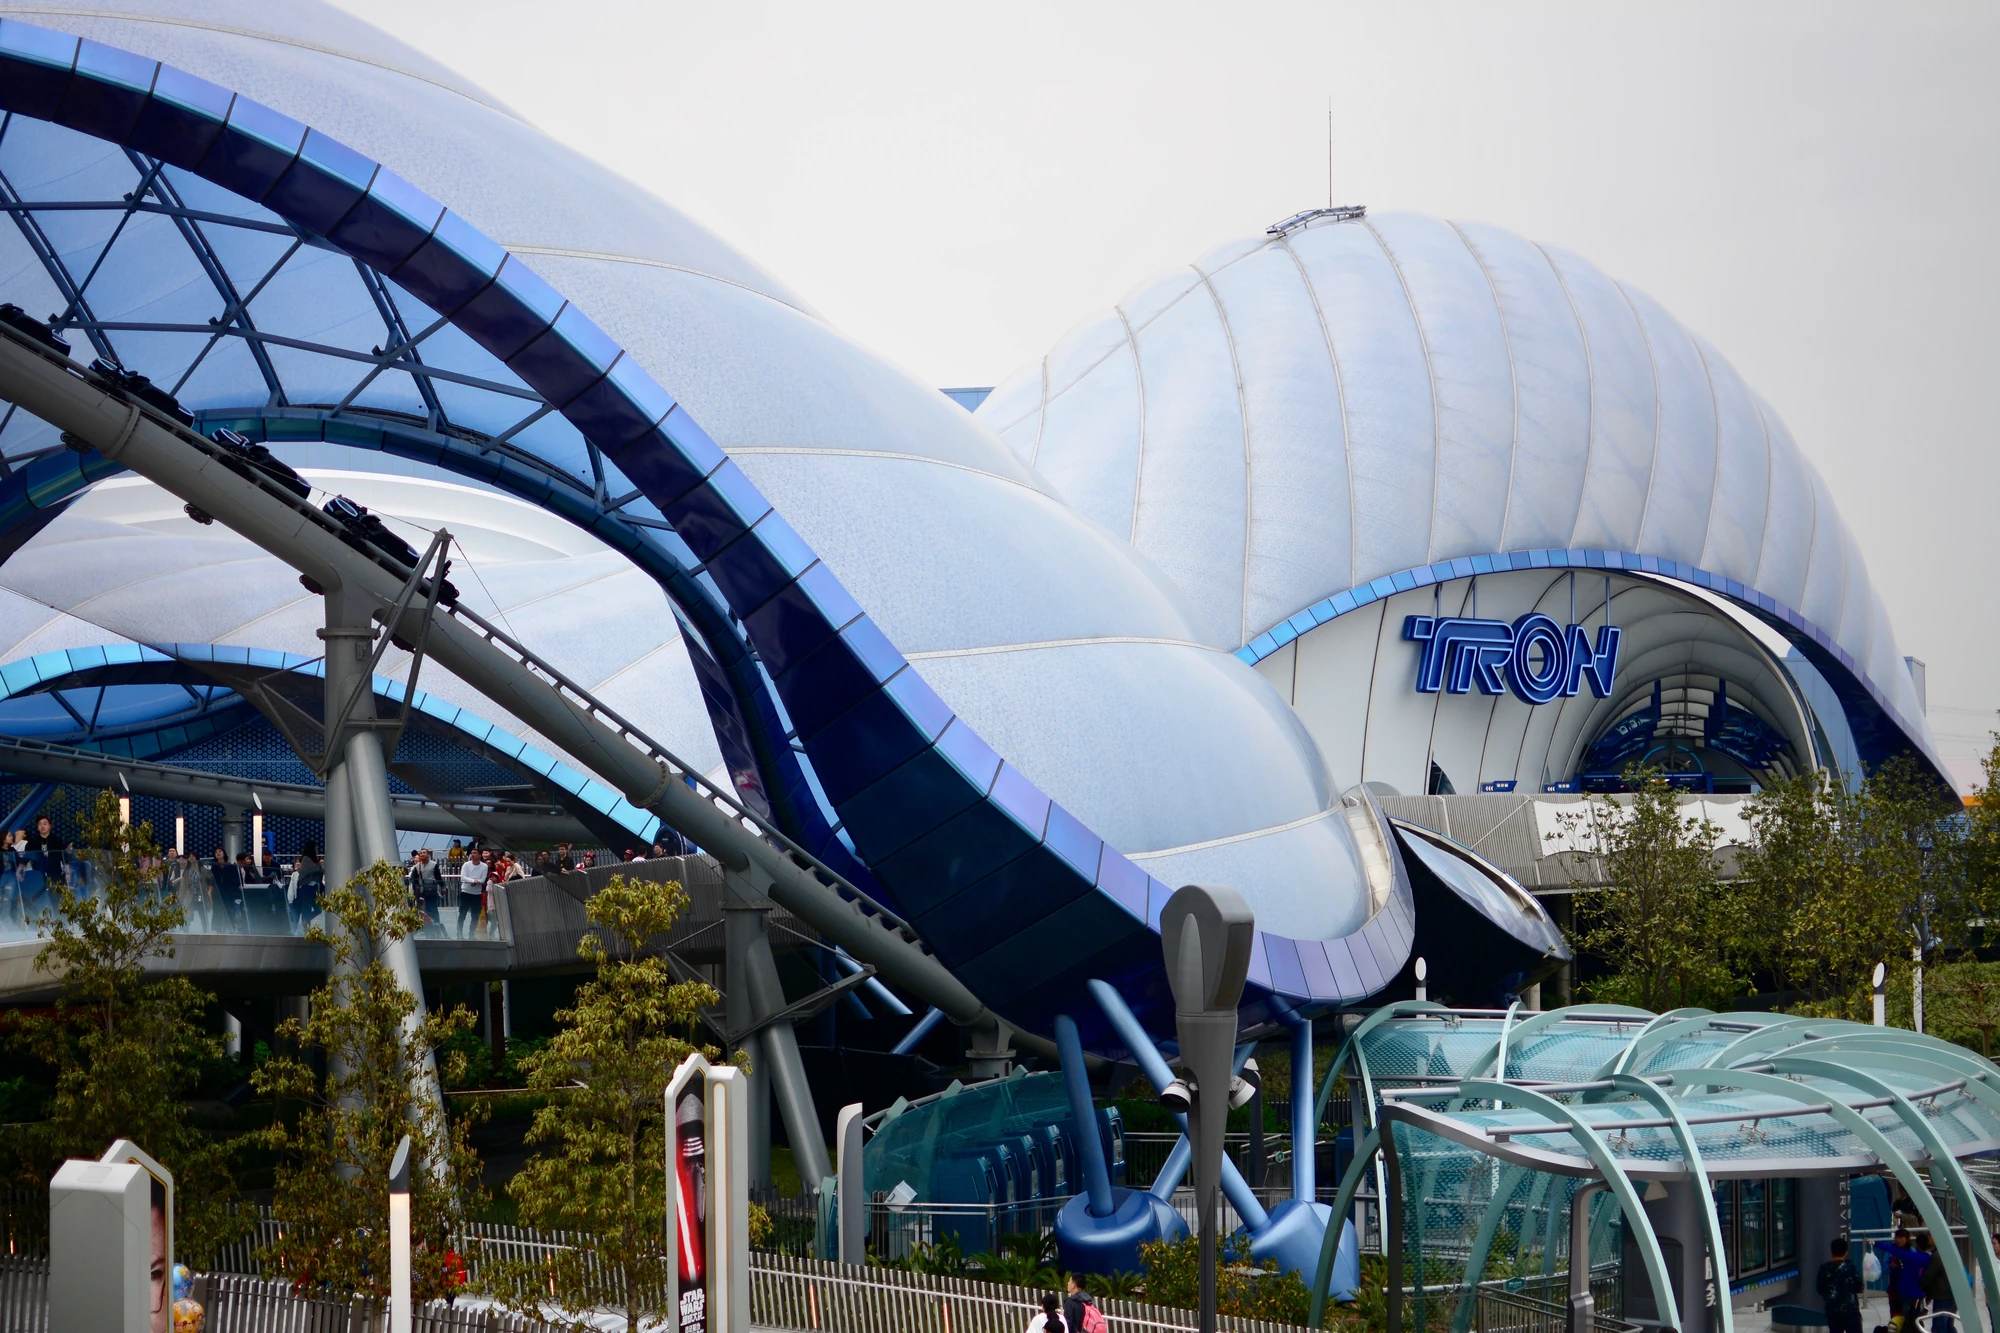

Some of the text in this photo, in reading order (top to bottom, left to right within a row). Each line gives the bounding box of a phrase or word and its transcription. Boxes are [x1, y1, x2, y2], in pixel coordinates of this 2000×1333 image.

[1402, 613, 1622, 705] TRON
[680, 1288, 705, 1306] STAR
[680, 1298, 705, 1317] WARS
